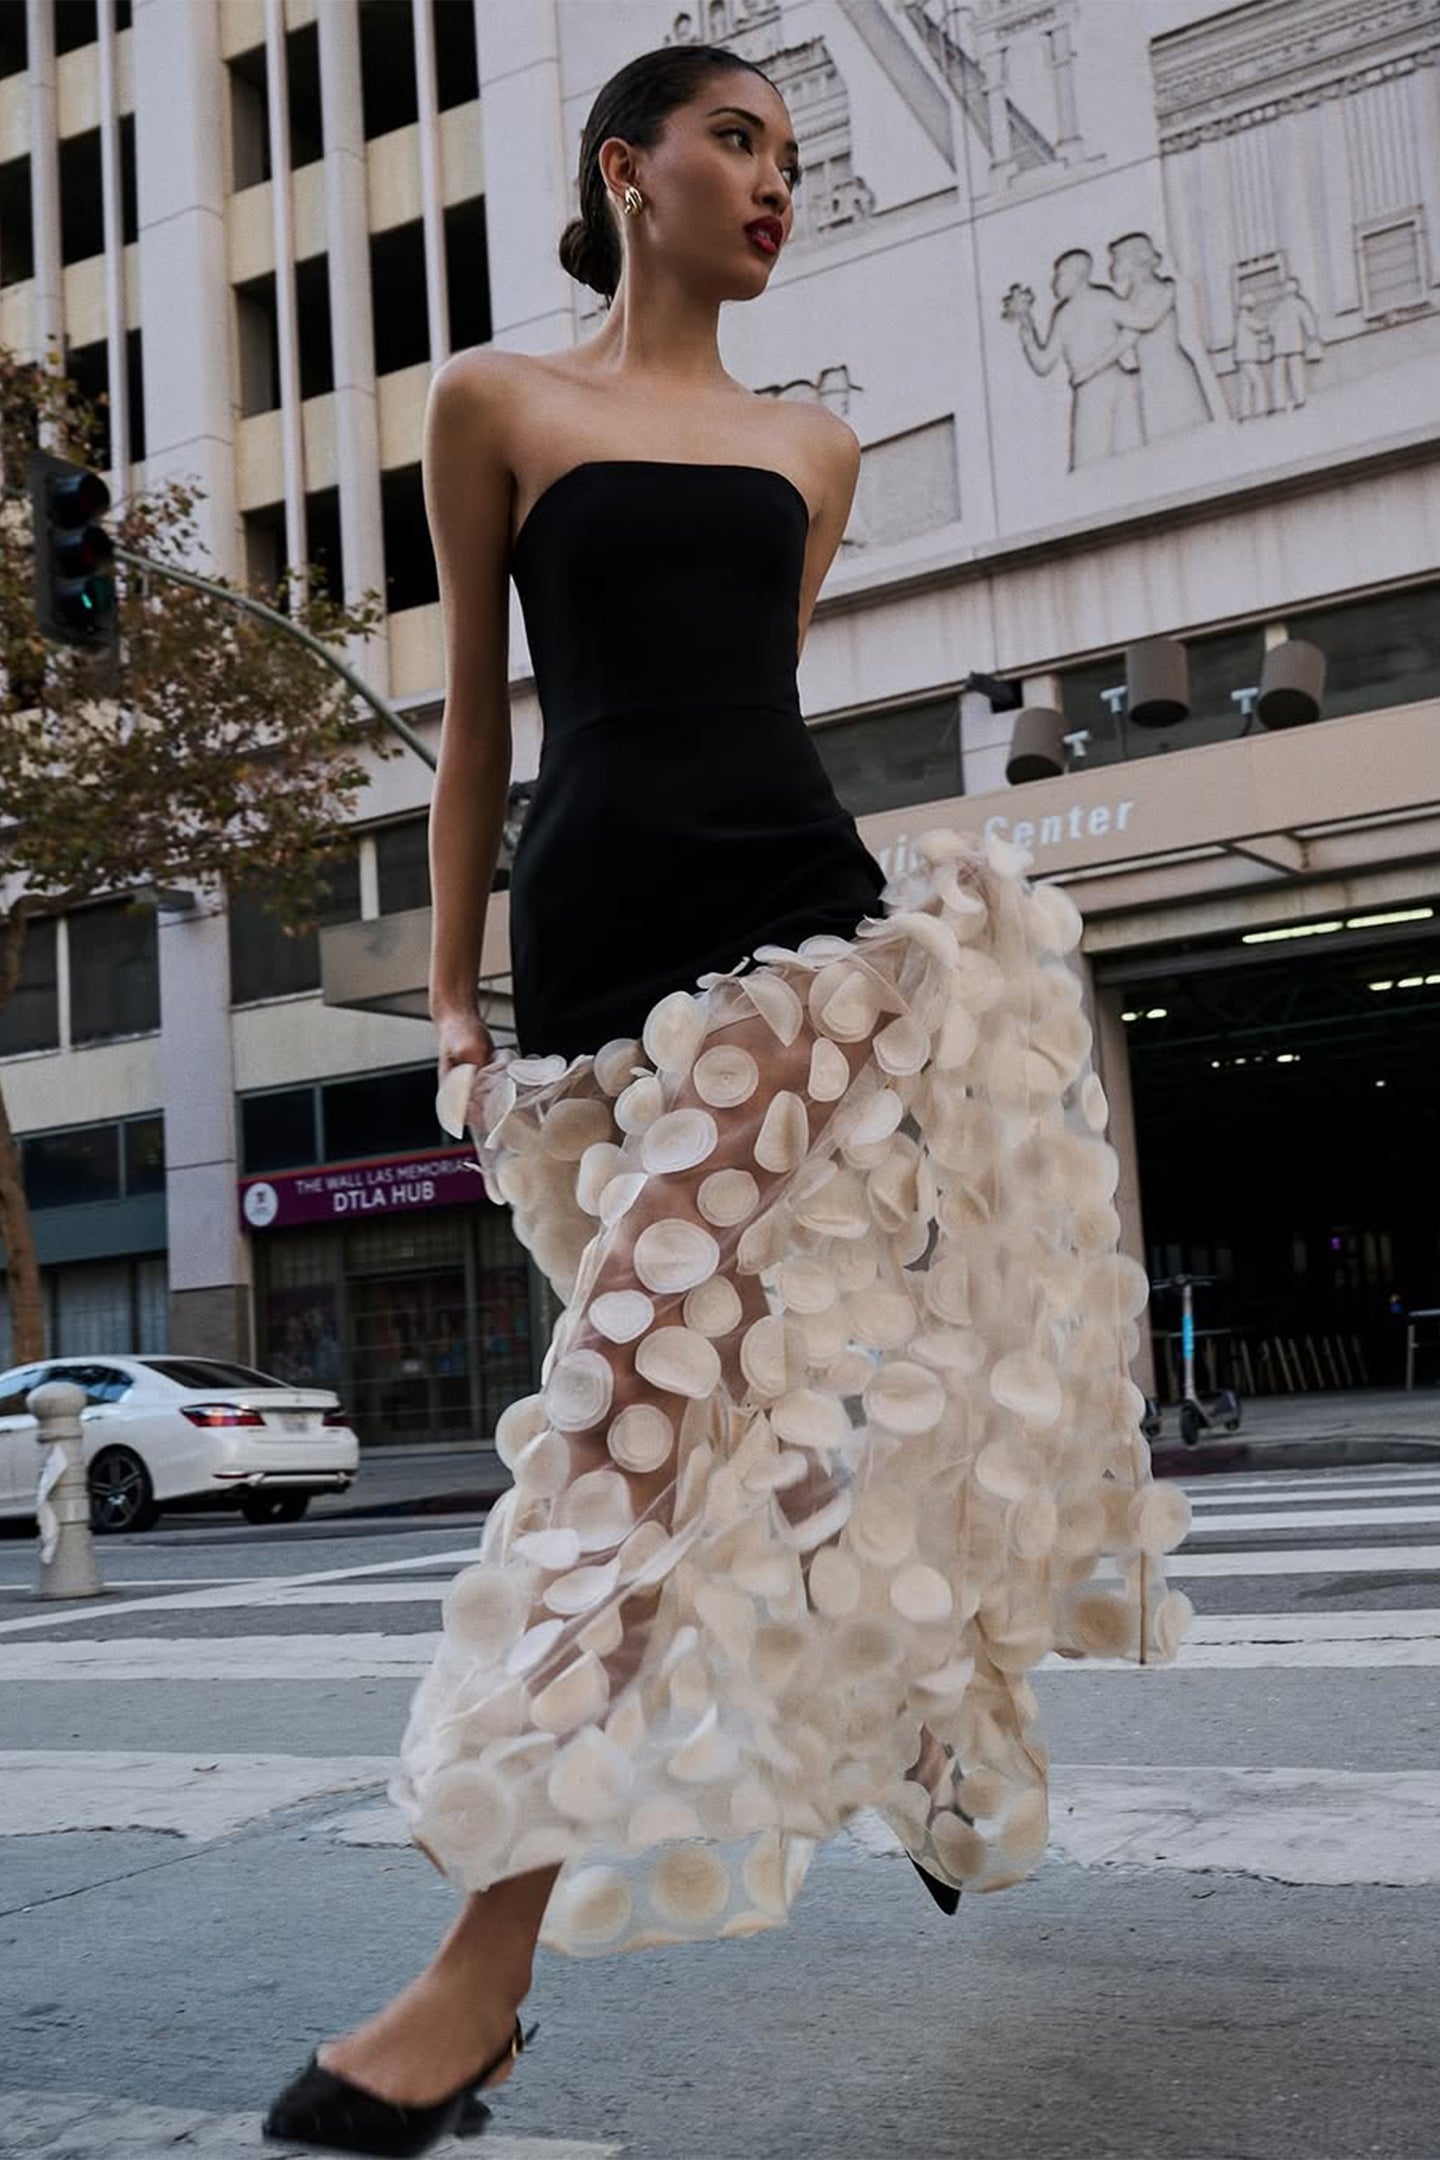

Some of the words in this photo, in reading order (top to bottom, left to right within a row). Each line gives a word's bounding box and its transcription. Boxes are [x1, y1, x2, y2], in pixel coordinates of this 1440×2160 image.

[294, 1178, 323, 1195] THE
[326, 1173, 363, 1189] WALL
[366, 1168, 393, 1184] LAS
[333, 1188, 387, 1212] DTLA
[391, 1181, 435, 1205] HUB
